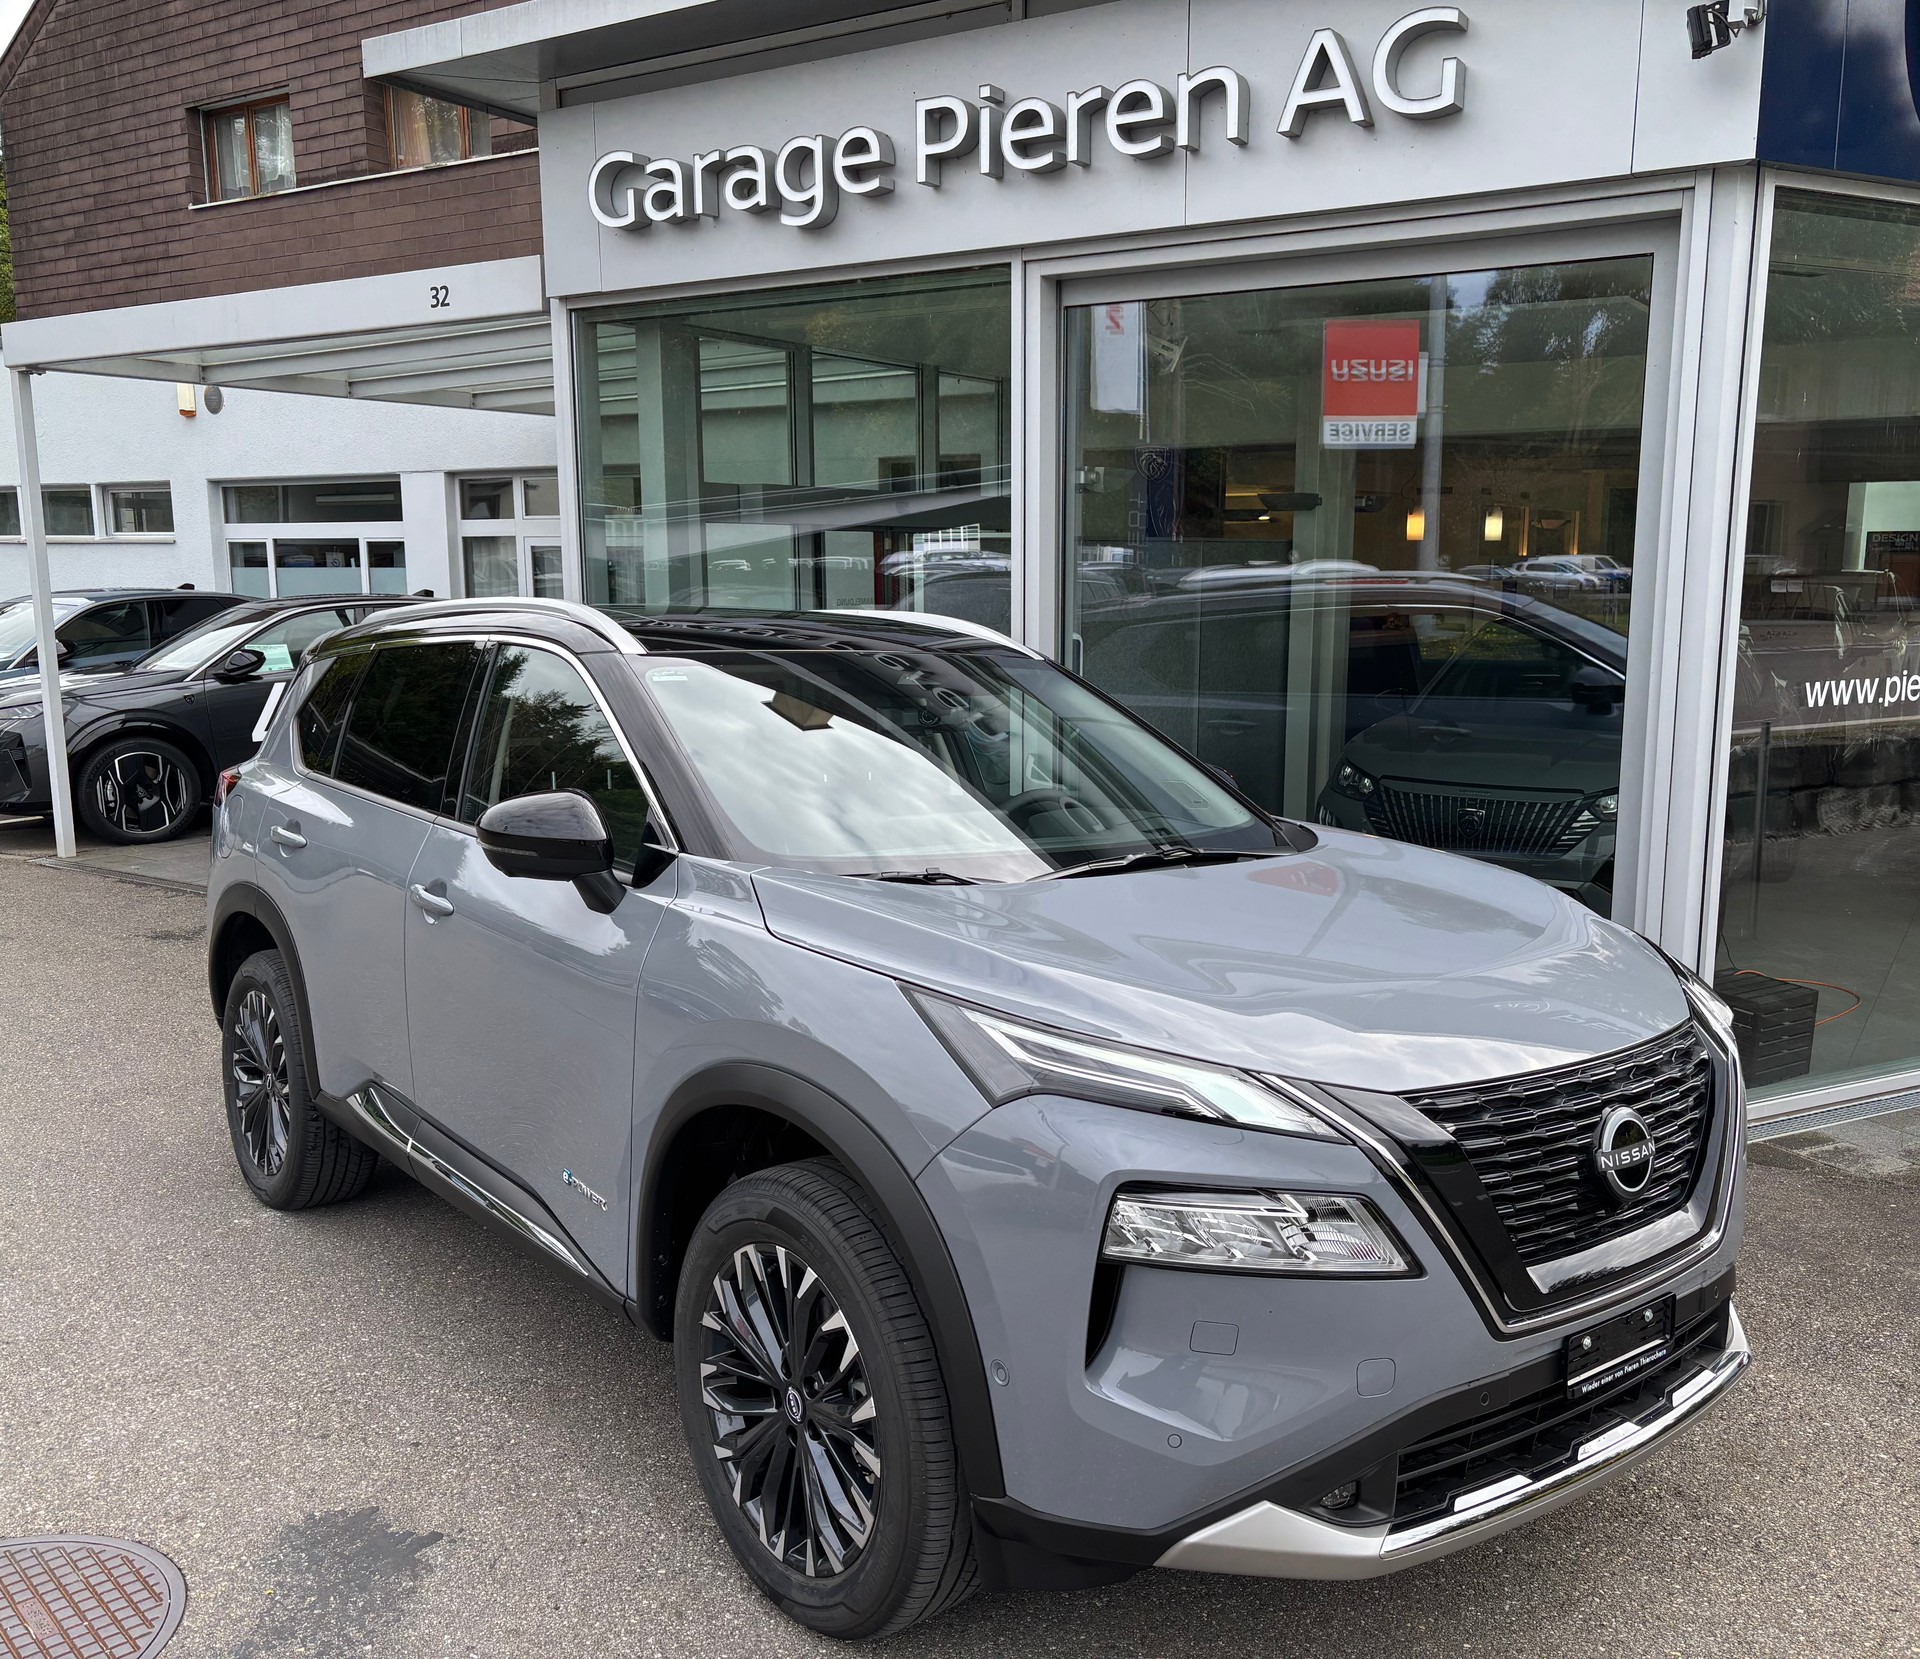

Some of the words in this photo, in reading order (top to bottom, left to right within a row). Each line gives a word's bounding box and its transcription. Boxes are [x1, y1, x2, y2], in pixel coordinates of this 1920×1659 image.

[587, 125, 896, 231] Garage
[914, 65, 1250, 187] Pieren
[1276, 6, 1469, 138] AG
[430, 285, 450, 308] 32
[1601, 1142, 1655, 1169] NISSAN
[1581, 1379, 1600, 1393] Wieder
[1601, 1374, 1614, 1385] einer
[1614, 1369, 1624, 1379] von
